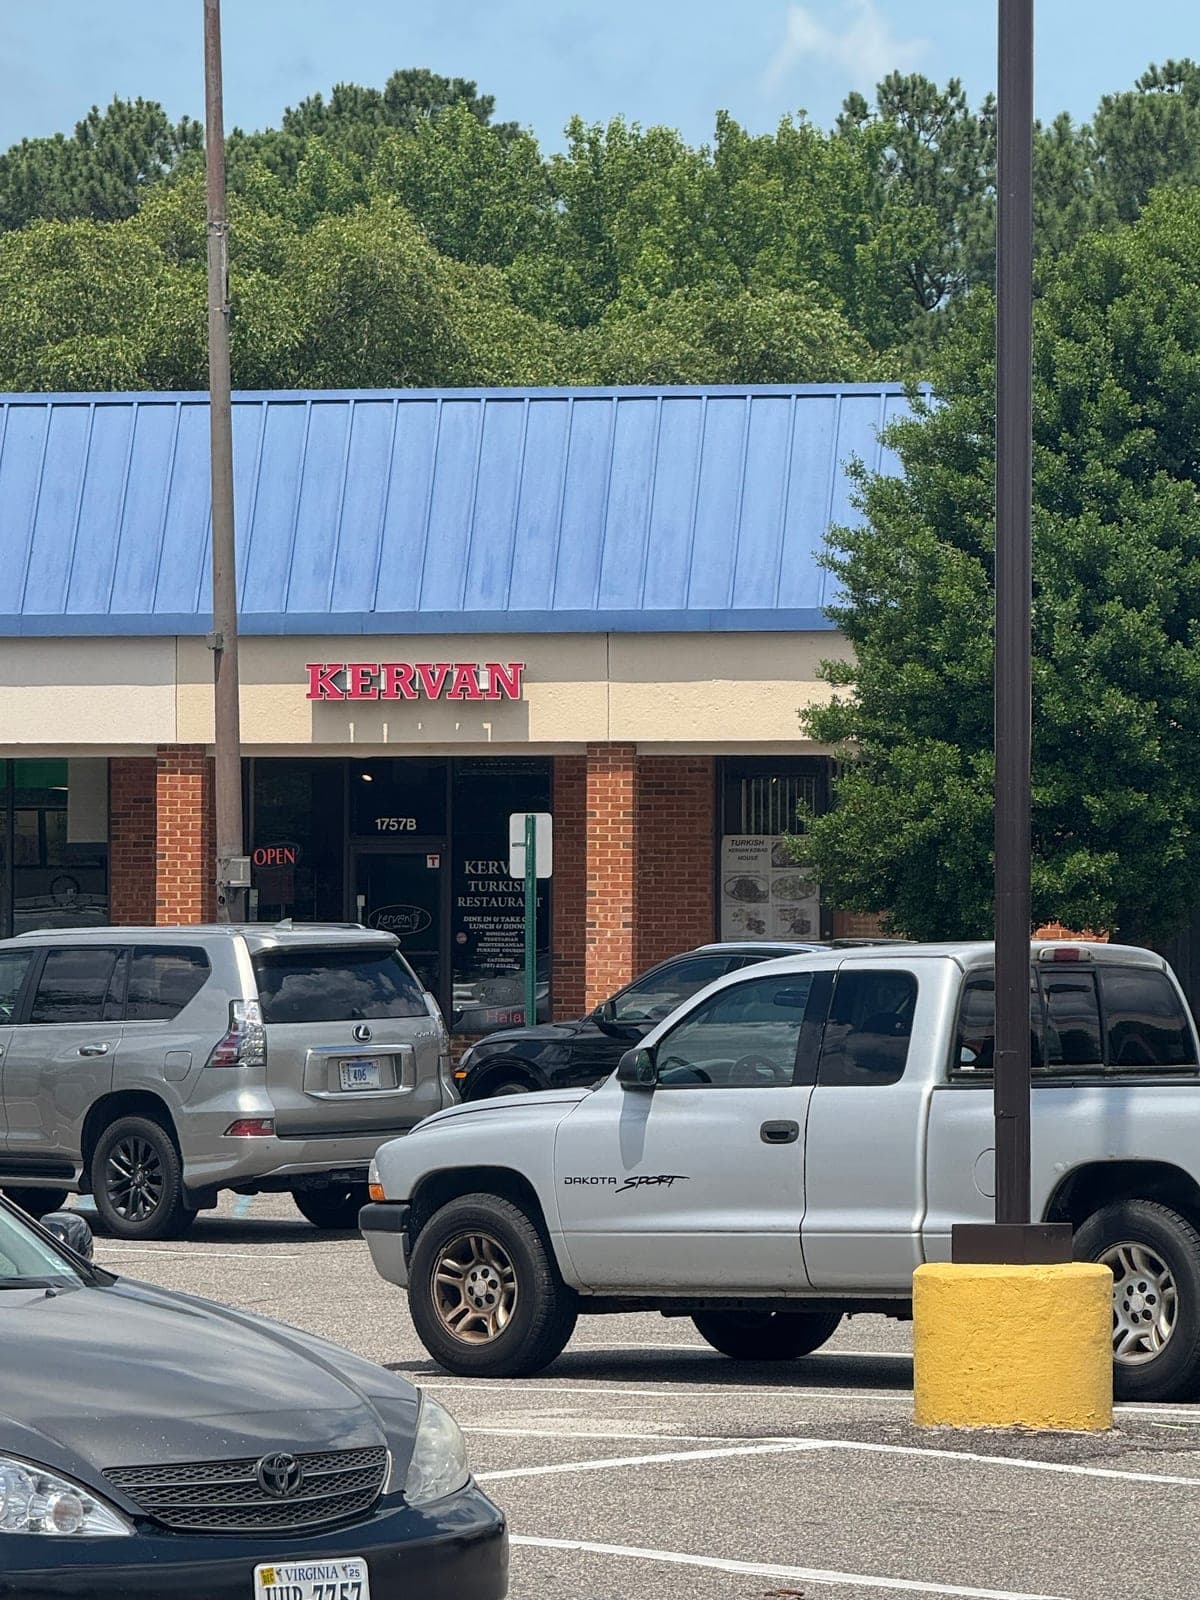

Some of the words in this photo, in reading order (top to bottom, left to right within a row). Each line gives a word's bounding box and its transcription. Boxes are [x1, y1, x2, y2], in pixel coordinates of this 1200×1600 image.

[305, 663, 525, 700] KERVAN
[375, 818, 417, 831] 1757B
[253, 848, 296, 865] OPEN
[464, 861, 511, 875] KERV
[457, 897, 543, 908] RESTAURAT
[564, 1177, 617, 1185] DAKOTA
[614, 1175, 690, 1193] SPORT
[285, 1566, 339, 1582] VIRGINIA
[349, 1569, 360, 1577] 25
